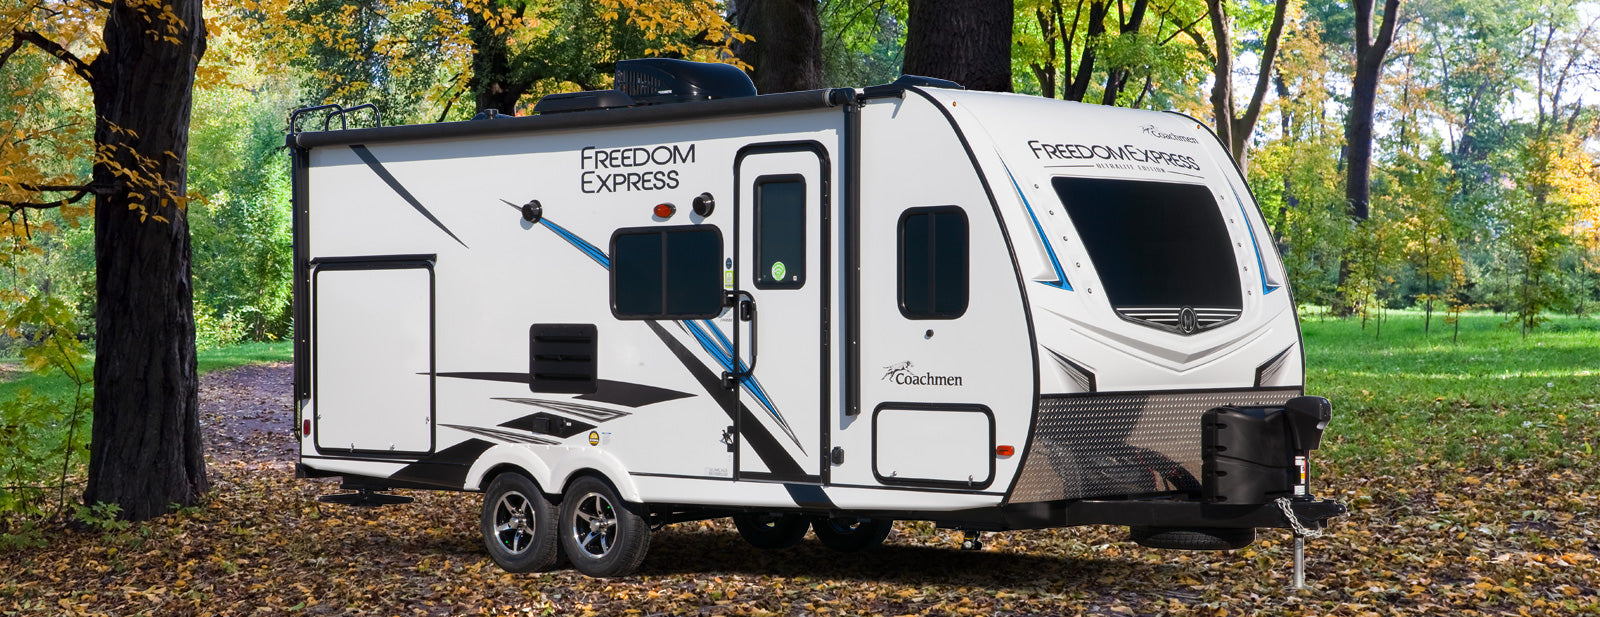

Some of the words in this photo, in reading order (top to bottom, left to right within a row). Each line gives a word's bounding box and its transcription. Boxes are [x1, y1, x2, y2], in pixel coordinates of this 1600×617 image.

[1150, 130, 1199, 144] Coachmen
[580, 144, 696, 169] FREEDOM
[580, 170, 680, 194] EXPRESS
[895, 372, 963, 386] Coachmen
